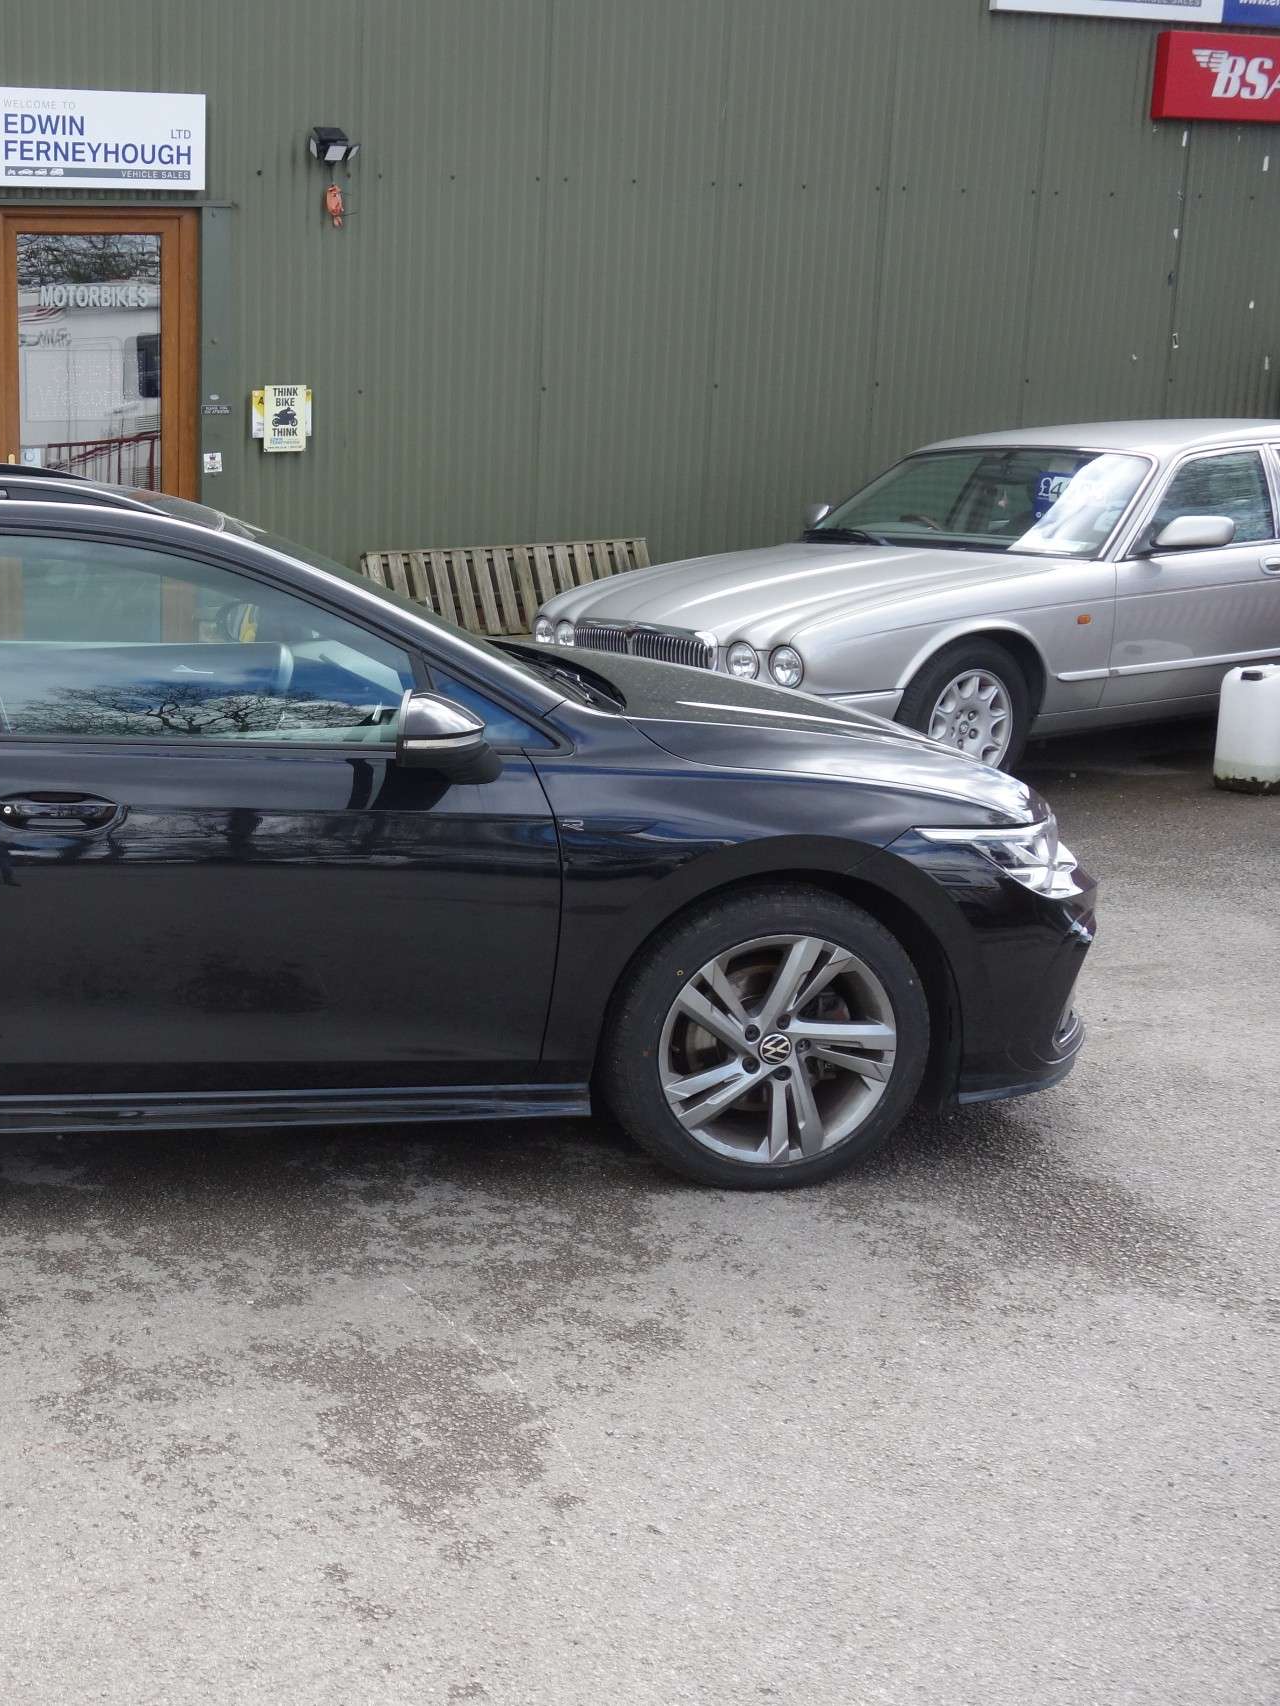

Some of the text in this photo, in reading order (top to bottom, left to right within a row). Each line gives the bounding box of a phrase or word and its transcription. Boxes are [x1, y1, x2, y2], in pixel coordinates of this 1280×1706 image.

[3, 98, 76, 110] WELCOME TO
[4, 113, 85, 136] EDWIN
[170, 128, 191, 140] LTD
[4, 139, 191, 165] FERNEYHOUGH
[121, 170, 189, 180] VEHICLE SALES
[40, 285, 149, 308] MOTORBIKES
[273, 387, 299, 397] THINK
[276, 397, 295, 407] BIKE
[272, 428, 298, 437] THINK
